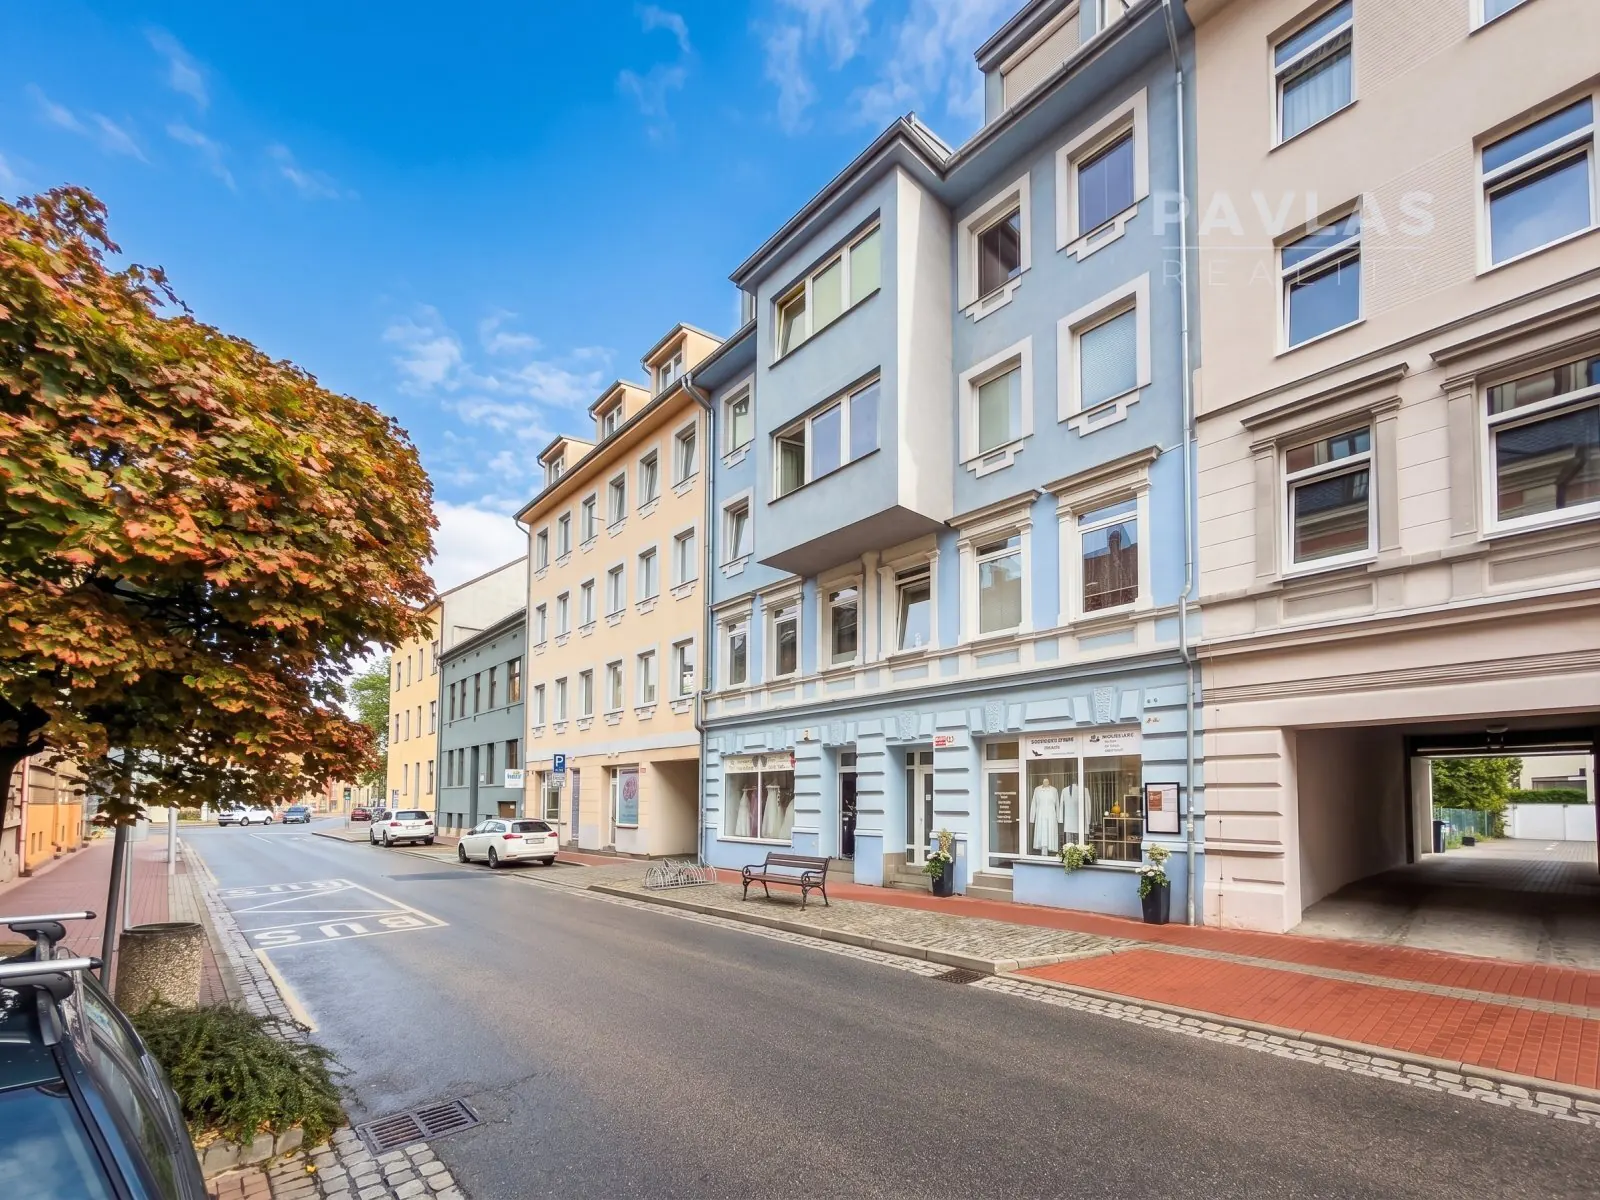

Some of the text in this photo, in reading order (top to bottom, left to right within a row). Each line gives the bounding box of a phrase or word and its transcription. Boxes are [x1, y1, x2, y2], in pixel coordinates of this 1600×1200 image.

[555, 755, 564, 767] P
[225, 879, 343, 898] BUS
[253, 915, 427, 946] BUS
